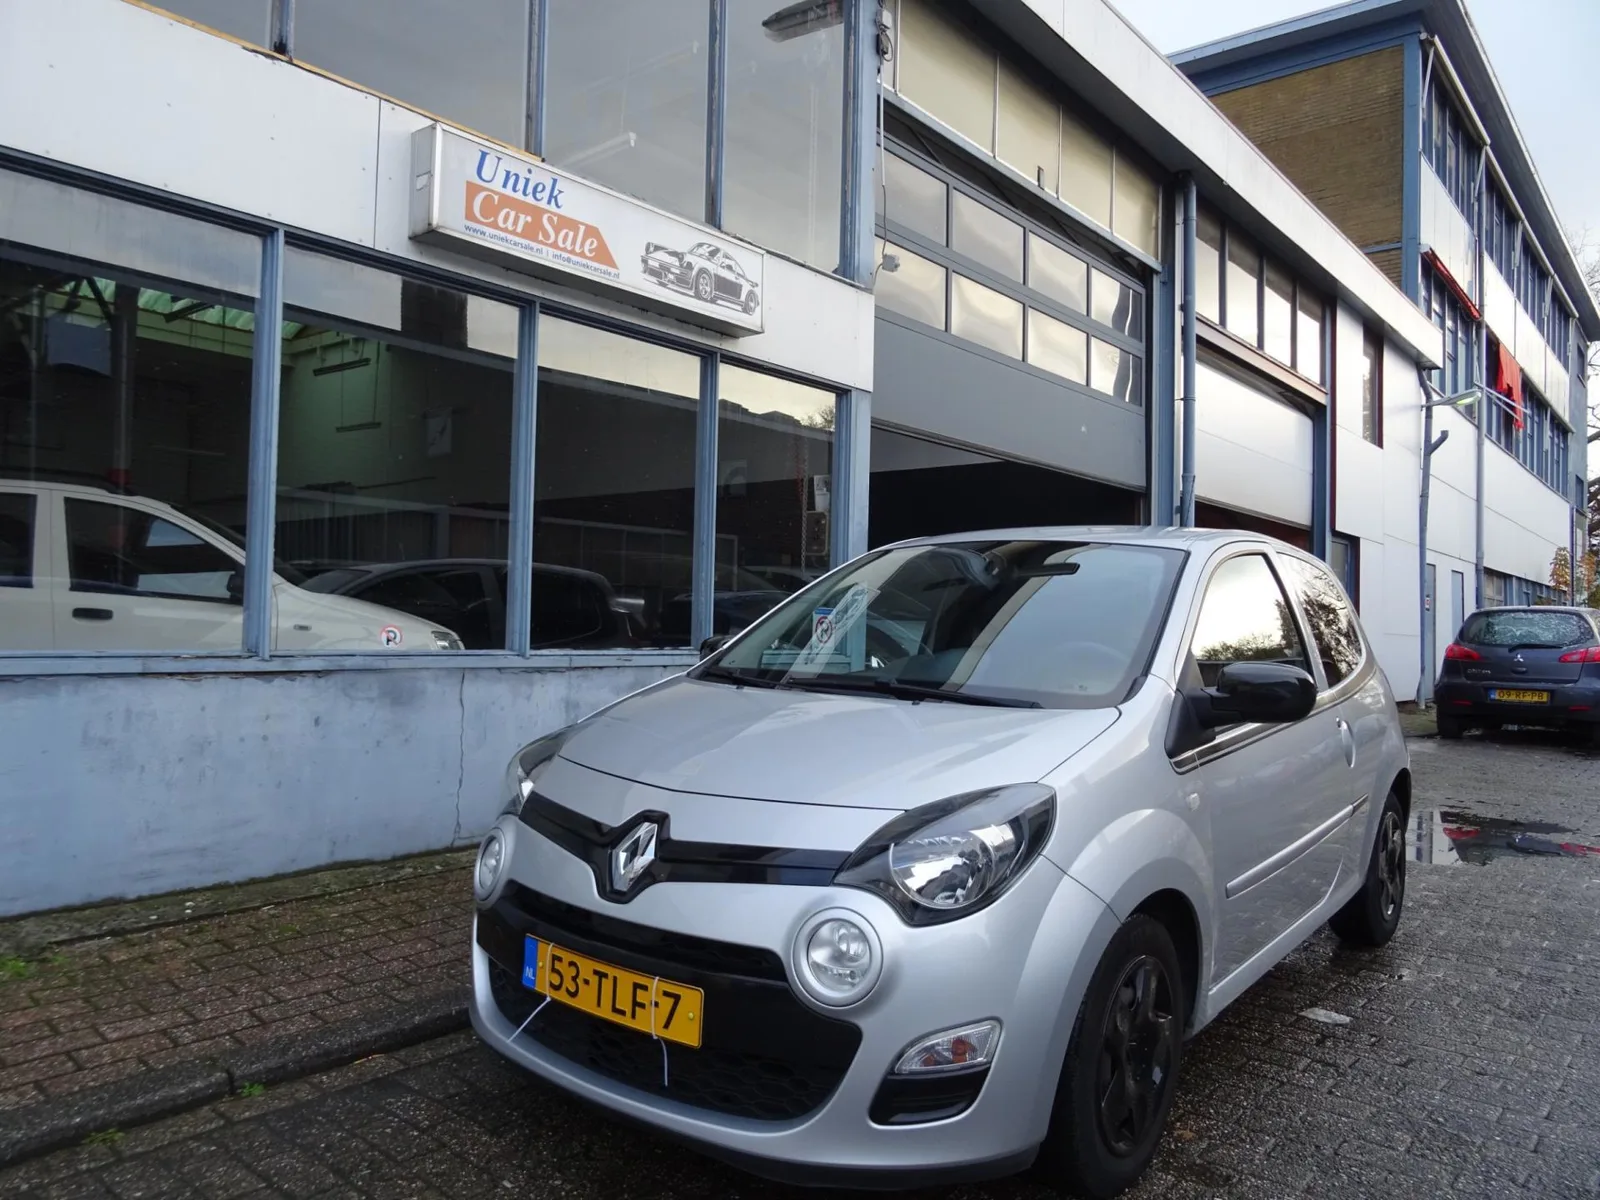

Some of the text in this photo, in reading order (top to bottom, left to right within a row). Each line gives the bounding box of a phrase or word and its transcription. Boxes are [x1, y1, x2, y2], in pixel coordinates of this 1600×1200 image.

[476, 149, 564, 209] Uniek
[464, 224, 620, 279] www.uniekcarsale.nl info@uniekcarsale.nl
[473, 191, 598, 258] Car Sale
[548, 953, 682, 1030] 53-TLF-7
